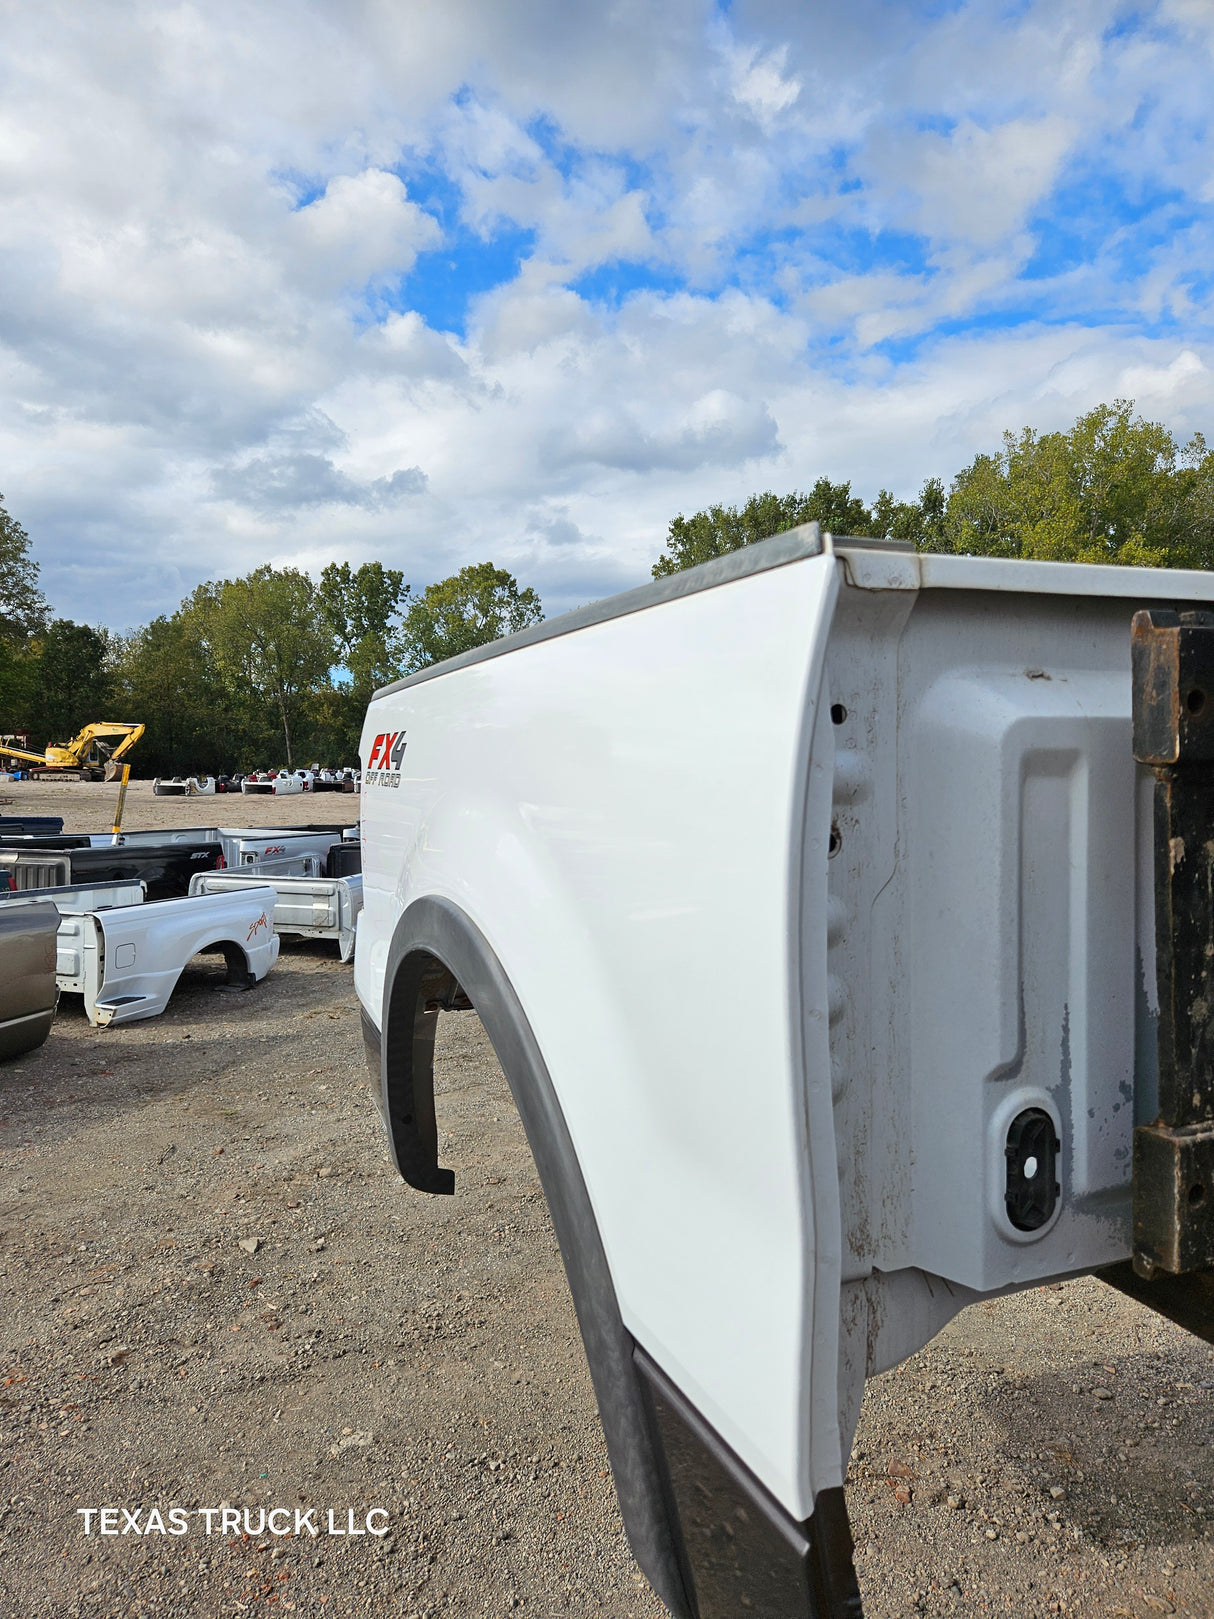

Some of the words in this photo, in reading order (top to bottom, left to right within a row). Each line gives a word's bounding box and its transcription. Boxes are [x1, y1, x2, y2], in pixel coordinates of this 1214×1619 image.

[367, 731, 407, 770] FX4
[365, 771, 379, 785] OFF
[378, 772, 402, 789] ROAD
[189, 851, 211, 860] STX
[264, 845, 287, 856] FX4
